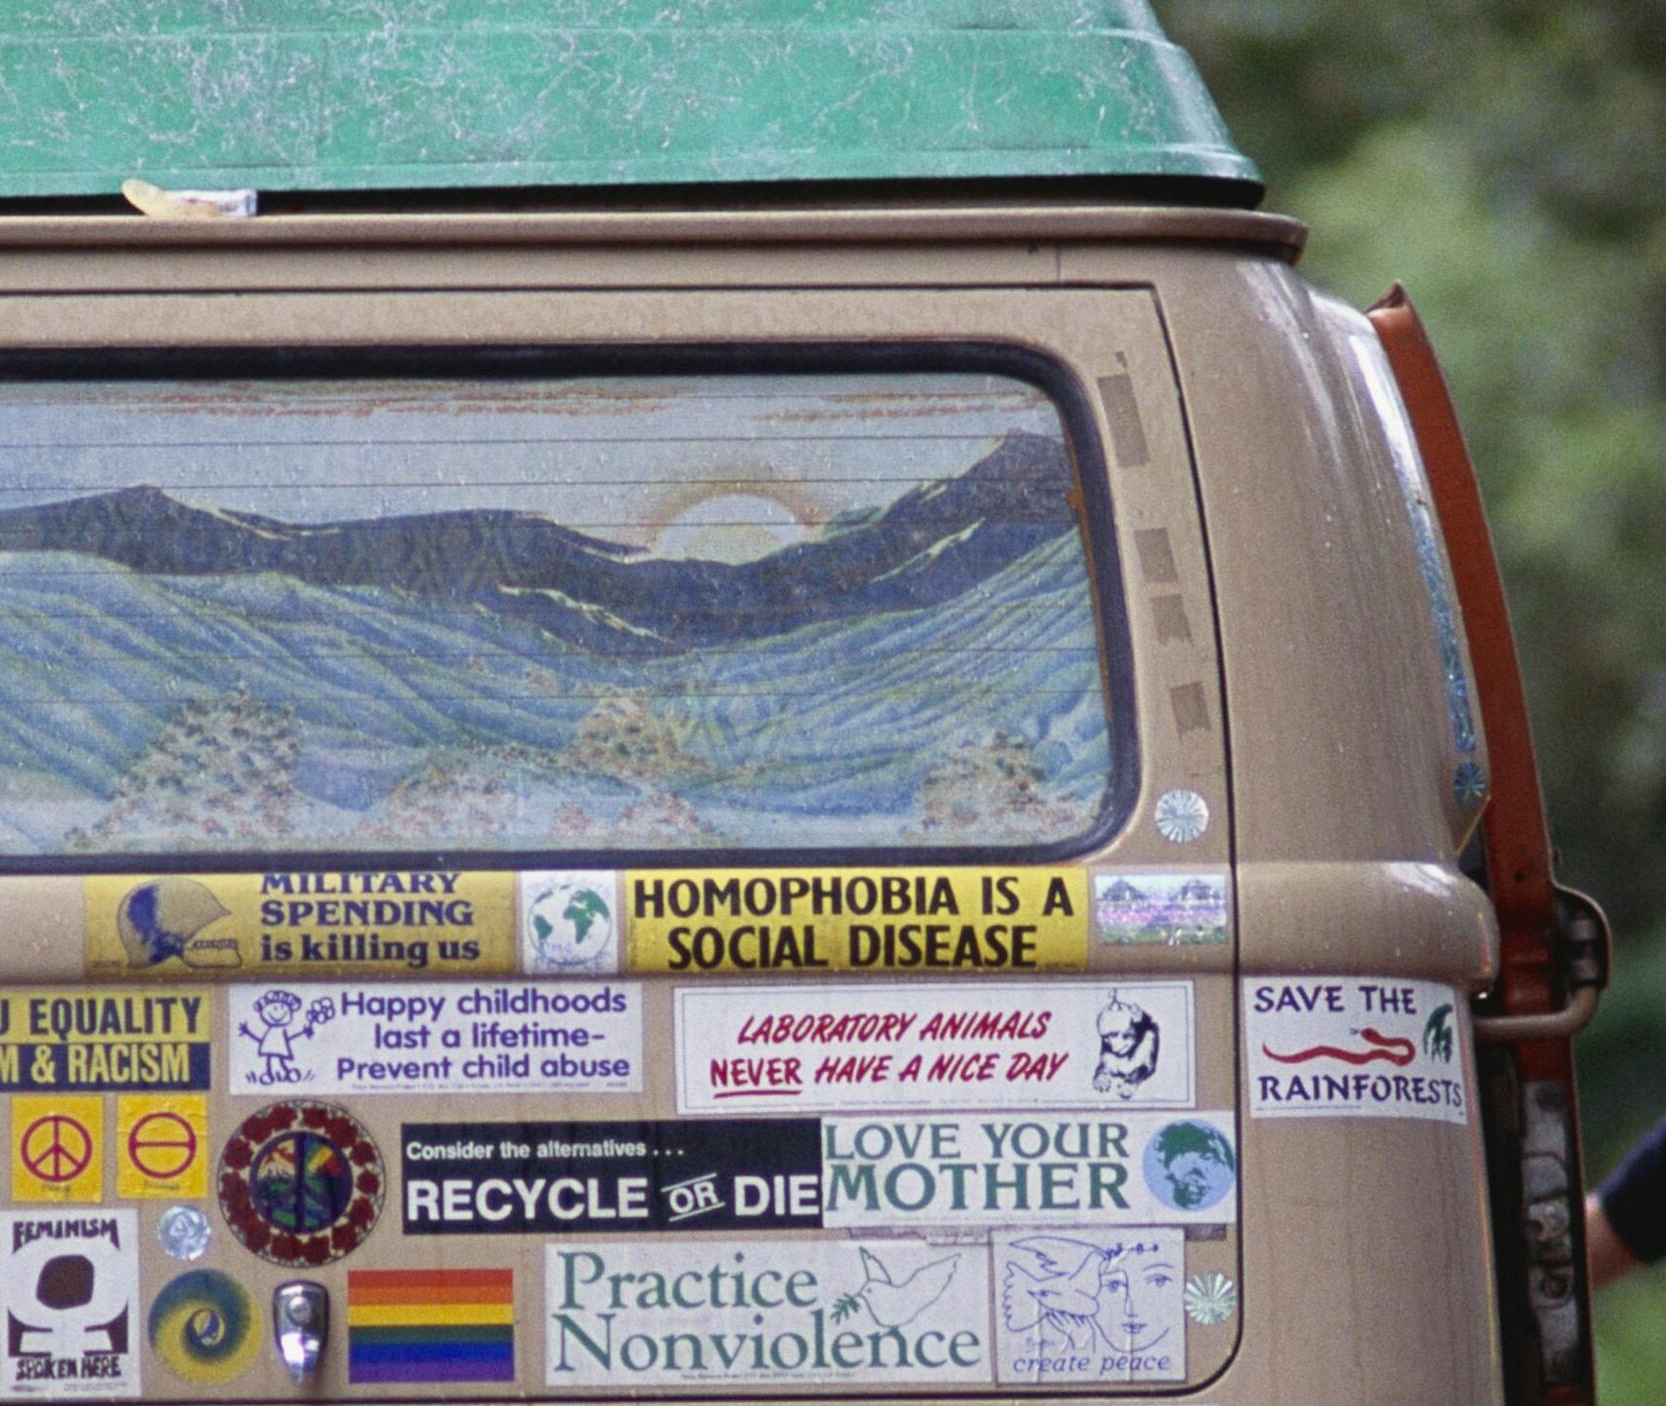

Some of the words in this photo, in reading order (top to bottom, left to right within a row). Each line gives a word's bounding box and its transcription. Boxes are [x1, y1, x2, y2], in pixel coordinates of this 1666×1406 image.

[259, 873, 461, 894] MILITARY
[633, 876, 960, 919] HOMOPHOBIA
[982, 876, 1020, 916] IS
[1042, 876, 1074, 916] A
[260, 900, 474, 926] SPENDING
[261, 934, 292, 961] is
[300, 933, 429, 968] killing
[437, 939, 480, 961] us
[667, 925, 829, 971] SOCIAL
[849, 923, 1038, 969] DISEASE
[341, 992, 445, 1021] Happy
[457, 986, 627, 1015] childhoods
[1254, 986, 1345, 1012] SAVE
[1358, 986, 1417, 1015] THE
[30, 997, 202, 1042] EQUALITY
[374, 1024, 432, 1049] last
[441, 1028, 461, 1048] a
[737, 1013, 918, 1044] LABORATORY
[920, 1011, 1052, 1041] ANIMALS
[30, 1044, 56, 1083] &
[68, 1043, 190, 1082] RACISM
[337, 1058, 452, 1081] Prevent
[462, 1054, 530, 1079] child
[541, 1054, 630, 1078] abuse
[711, 1057, 803, 1086] NEVER
[815, 1056, 892, 1085] HAVE
[899, 1055, 921, 1082] A
[927, 1053, 1000, 1083] NICE
[1005, 1052, 1068, 1082] DAY
[1258, 1075, 1462, 1107] RAINFORESTS
[406, 1142, 493, 1160] Consider
[500, 1142, 530, 1158] the
[537, 1140, 646, 1157] alternatives
[825, 1123, 961, 1160] LOVE
[981, 1123, 1130, 1159] YOUR
[407, 1177, 648, 1220] RECYCLE
[668, 1181, 719, 1214] OR
[734, 1175, 819, 1216] DIE
[826, 1162, 1130, 1211] MOTHER
[12, 1218, 121, 1254] FEMINISM
[557, 1251, 818, 1310] Practice
[552, 1308, 981, 1372] Nonviolence
[16, 1358, 78, 1380] SPOKEN
[81, 1357, 121, 1378] HERE
[1013, 1355, 1090, 1373] create
[1100, 1355, 1170, 1375] peace
